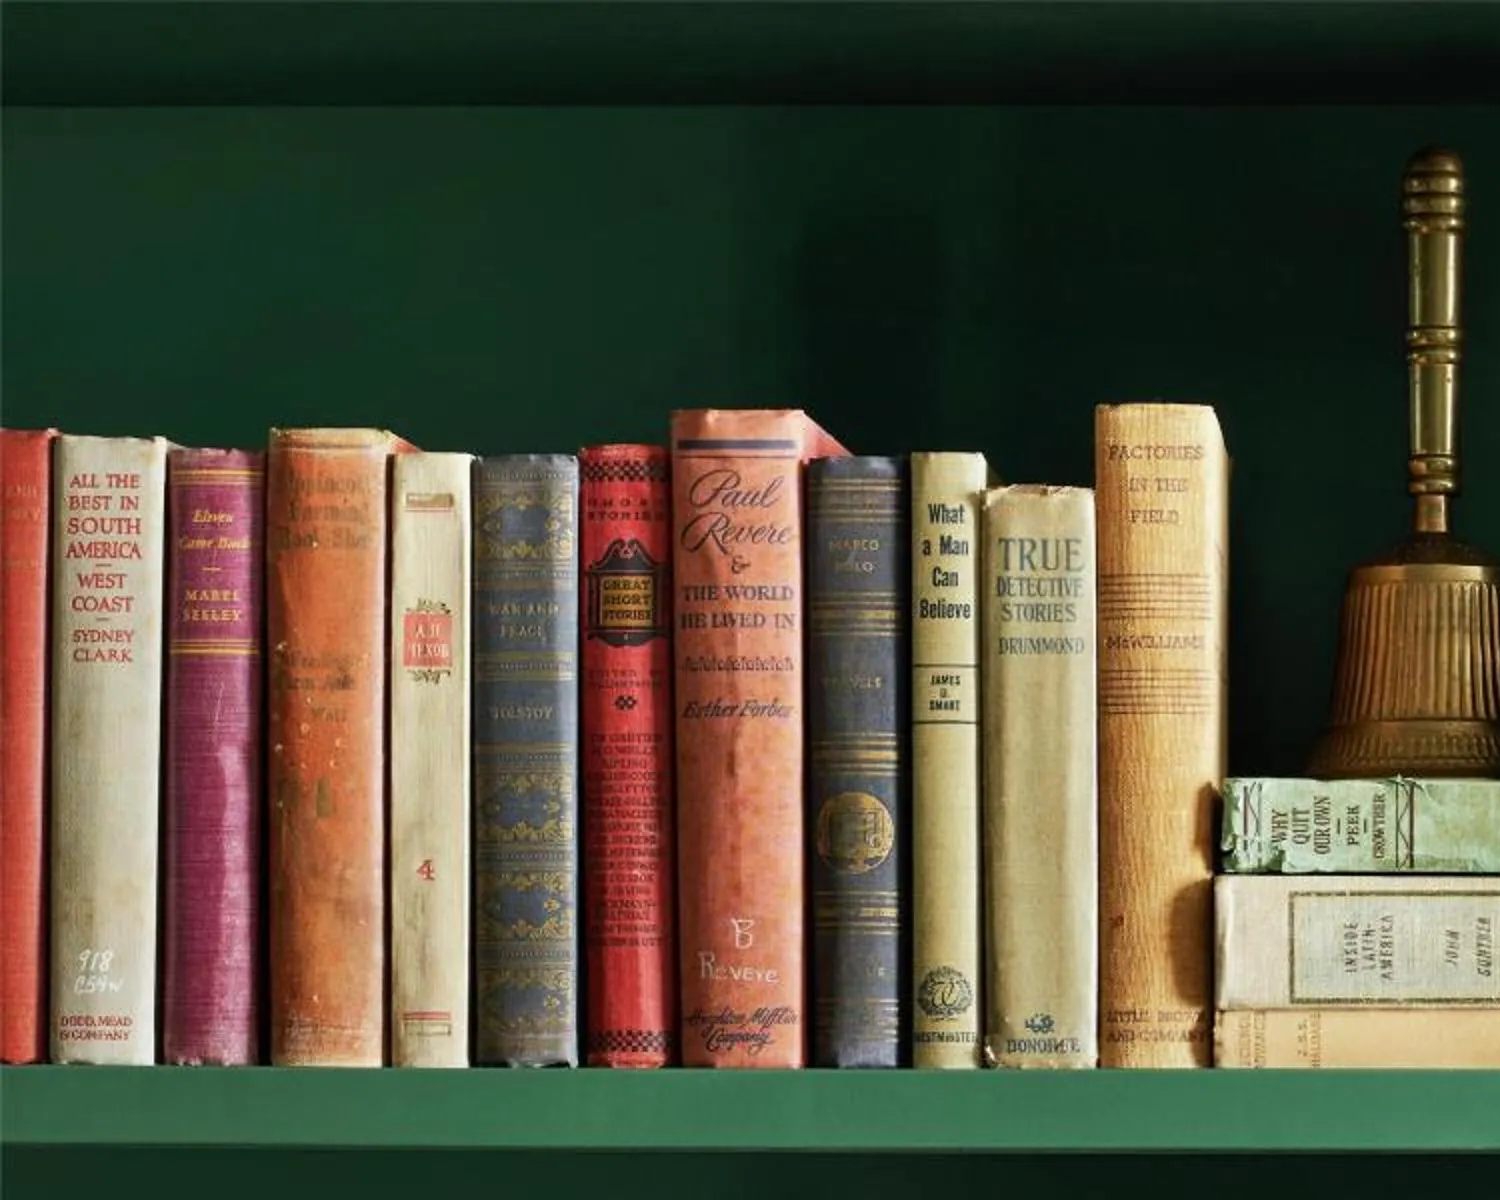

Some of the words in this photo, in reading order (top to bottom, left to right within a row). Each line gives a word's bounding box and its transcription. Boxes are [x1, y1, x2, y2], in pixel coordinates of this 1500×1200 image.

[1108, 445, 1204, 460] FACTORIES
[69, 473, 99, 489] ALL
[105, 473, 141, 489] THE
[689, 469, 785, 509] Paul
[1129, 478, 1148, 493] IN
[1153, 478, 1188, 493] THE
[66, 495, 112, 511] BEST
[120, 496, 139, 511] IN
[928, 503, 965, 525] What
[1129, 510, 1179, 524] FIELD
[67, 517, 141, 535] SOUTH
[680, 511, 791, 555] Revere
[65, 541, 142, 559] AMERICA
[922, 542, 932, 556] a
[939, 537, 969, 556] Man
[998, 538, 1085, 571] TRUE
[731, 555, 751, 574] &
[76, 573, 128, 589] WEST
[602, 579, 651, 591] GREAT
[931, 567, 959, 587] Can
[995, 577, 1084, 597] DETECTIVE
[602, 595, 651, 605] SHORT
[681, 586, 717, 601] THE
[724, 585, 794, 601] WORLD
[71, 595, 135, 613] COAST
[919, 600, 971, 620] Believe
[1001, 603, 1077, 623] STORIES
[680, 614, 707, 629] HE
[711, 614, 766, 629] LIVED
[774, 614, 795, 629] IN
[72, 629, 135, 643] SYDNEY
[72, 648, 133, 662] CLARK
[998, 637, 1085, 656] DRUMMOND
[929, 675, 961, 687] JAMES
[682, 699, 738, 719] Esther
[739, 699, 791, 719] Forbes
[929, 700, 960, 710] SMART
[1313, 795, 1332, 827] OWN
[1271, 808, 1289, 845] WHY
[1291, 808, 1311, 845] QUIT
[1346, 804, 1360, 846] PEEK
[1372, 793, 1387, 859] CROWTHER
[1313, 828, 1332, 855] OUR
[416, 859, 435, 880] 4
[1343, 921, 1358, 973] INSIDE
[1379, 914, 1395, 980] AMERICA
[1445, 929, 1460, 966] JOHN
[1475, 917, 1492, 977] GUNTHER
[78, 950, 114, 971] 918
[706, 1025, 775, 1054] Company
[1106, 1029, 1136, 1042] AND
